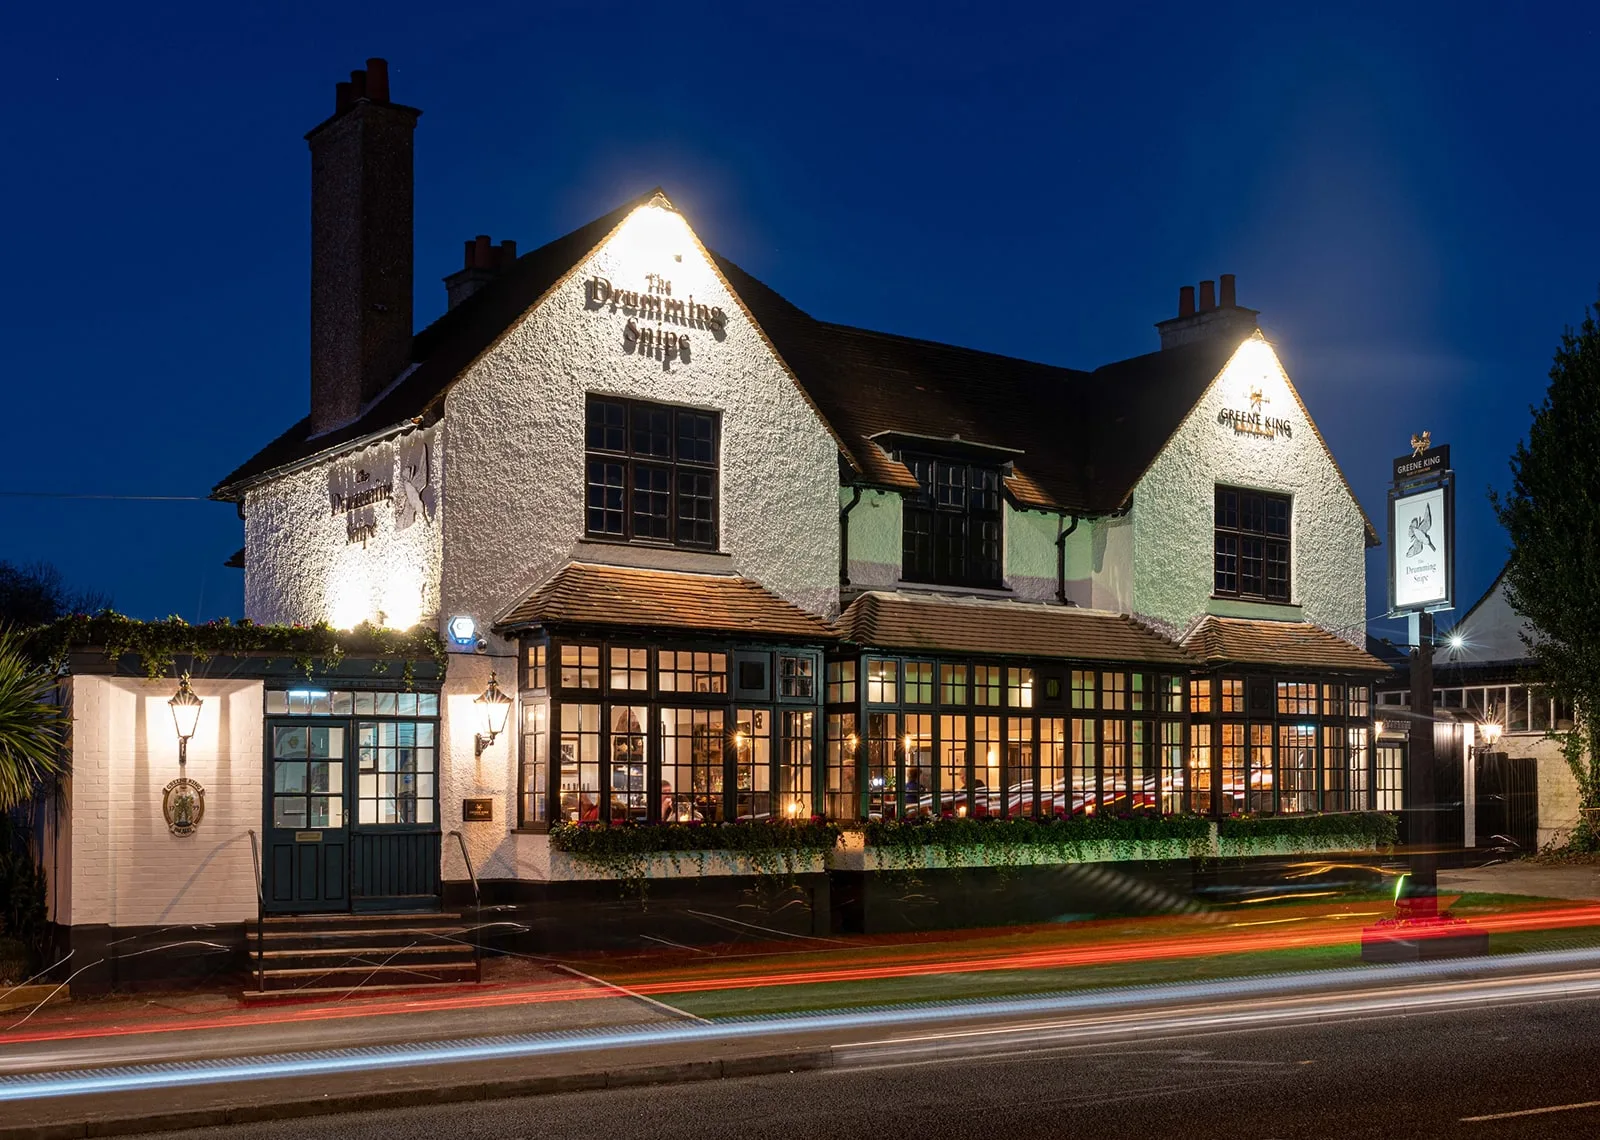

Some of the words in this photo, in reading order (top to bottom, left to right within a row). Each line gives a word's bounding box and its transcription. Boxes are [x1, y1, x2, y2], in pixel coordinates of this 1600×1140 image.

[645, 272, 672, 296] The
[591, 275, 723, 332] Drumming
[625, 317, 690, 357] Snipe
[1220, 407, 1263, 426] GREENE
[1264, 416, 1292, 432] KING
[1397, 460, 1423, 474] GREENE
[1423, 455, 1441, 467] KING
[347, 517, 378, 550] Snipe
